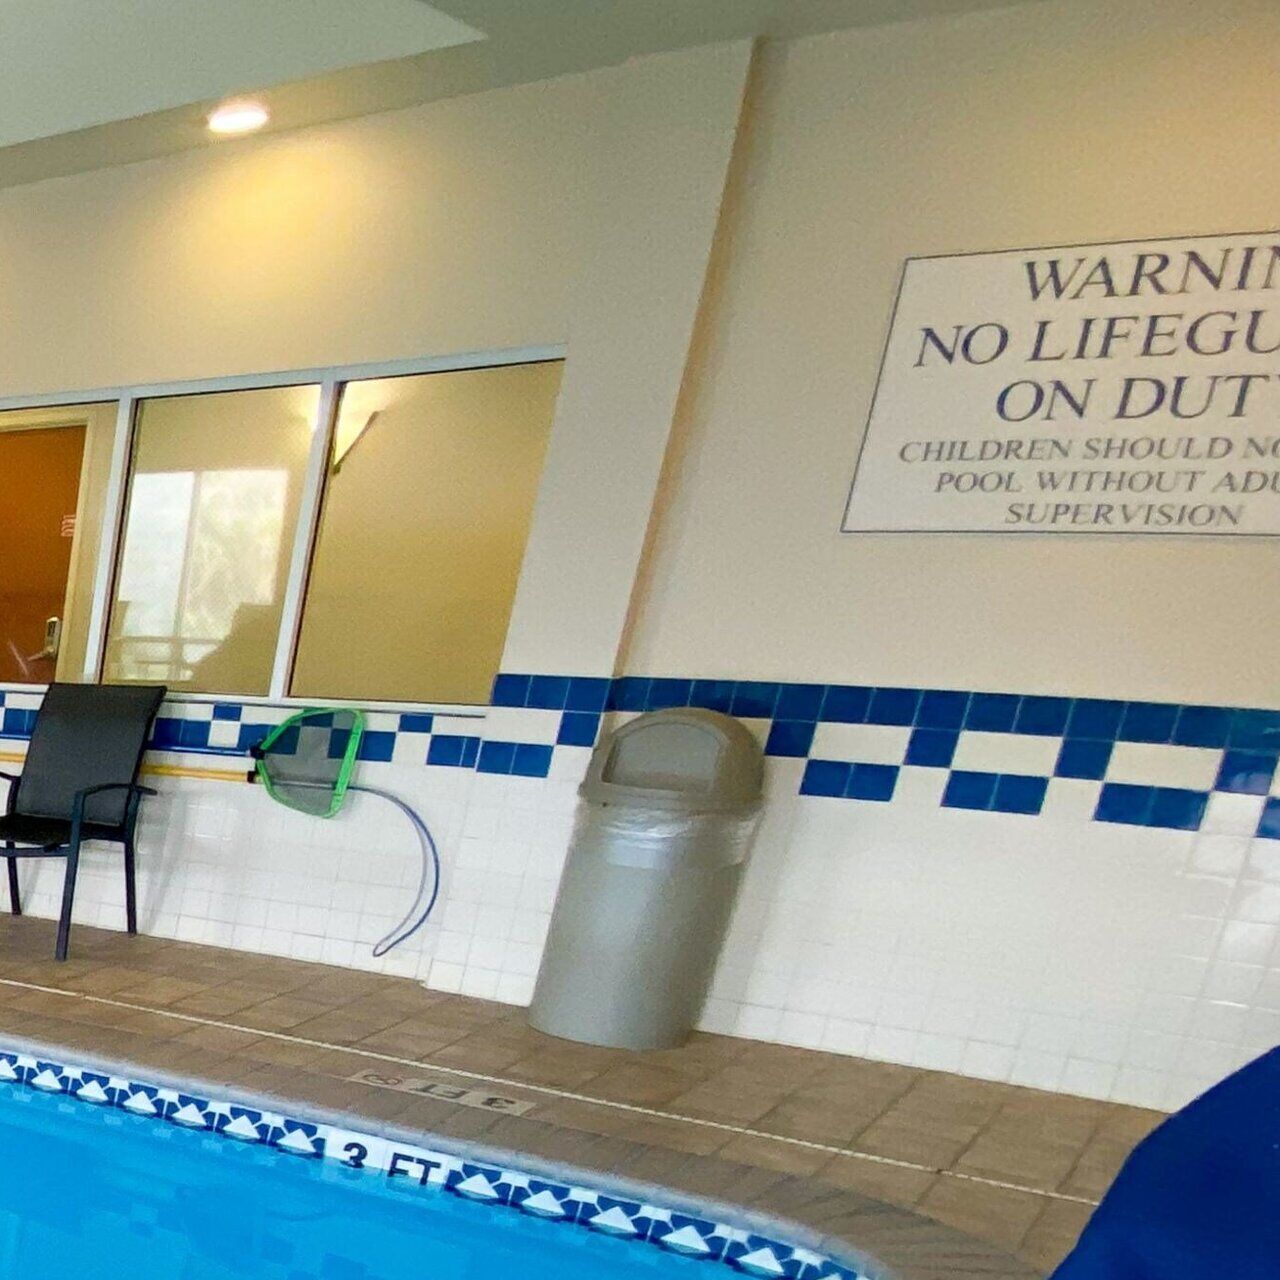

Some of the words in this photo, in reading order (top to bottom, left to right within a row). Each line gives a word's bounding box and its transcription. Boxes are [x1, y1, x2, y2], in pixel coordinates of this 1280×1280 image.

[913, 322, 1009, 368] NO
[995, 378, 1096, 422] ON
[1114, 374, 1280, 420] DUT
[899, 438, 1072, 463] CHILDREN
[1081, 436, 1233, 460] SHOULD
[934, 470, 1023, 494] POOL
[1036, 470, 1207, 493] WITHOUT
[1005, 502, 1245, 527] SUPERVISION
[410, 1083, 472, 1099] FT
[341, 1142, 368, 1169] 3
[387, 1152, 442, 1186] FT
